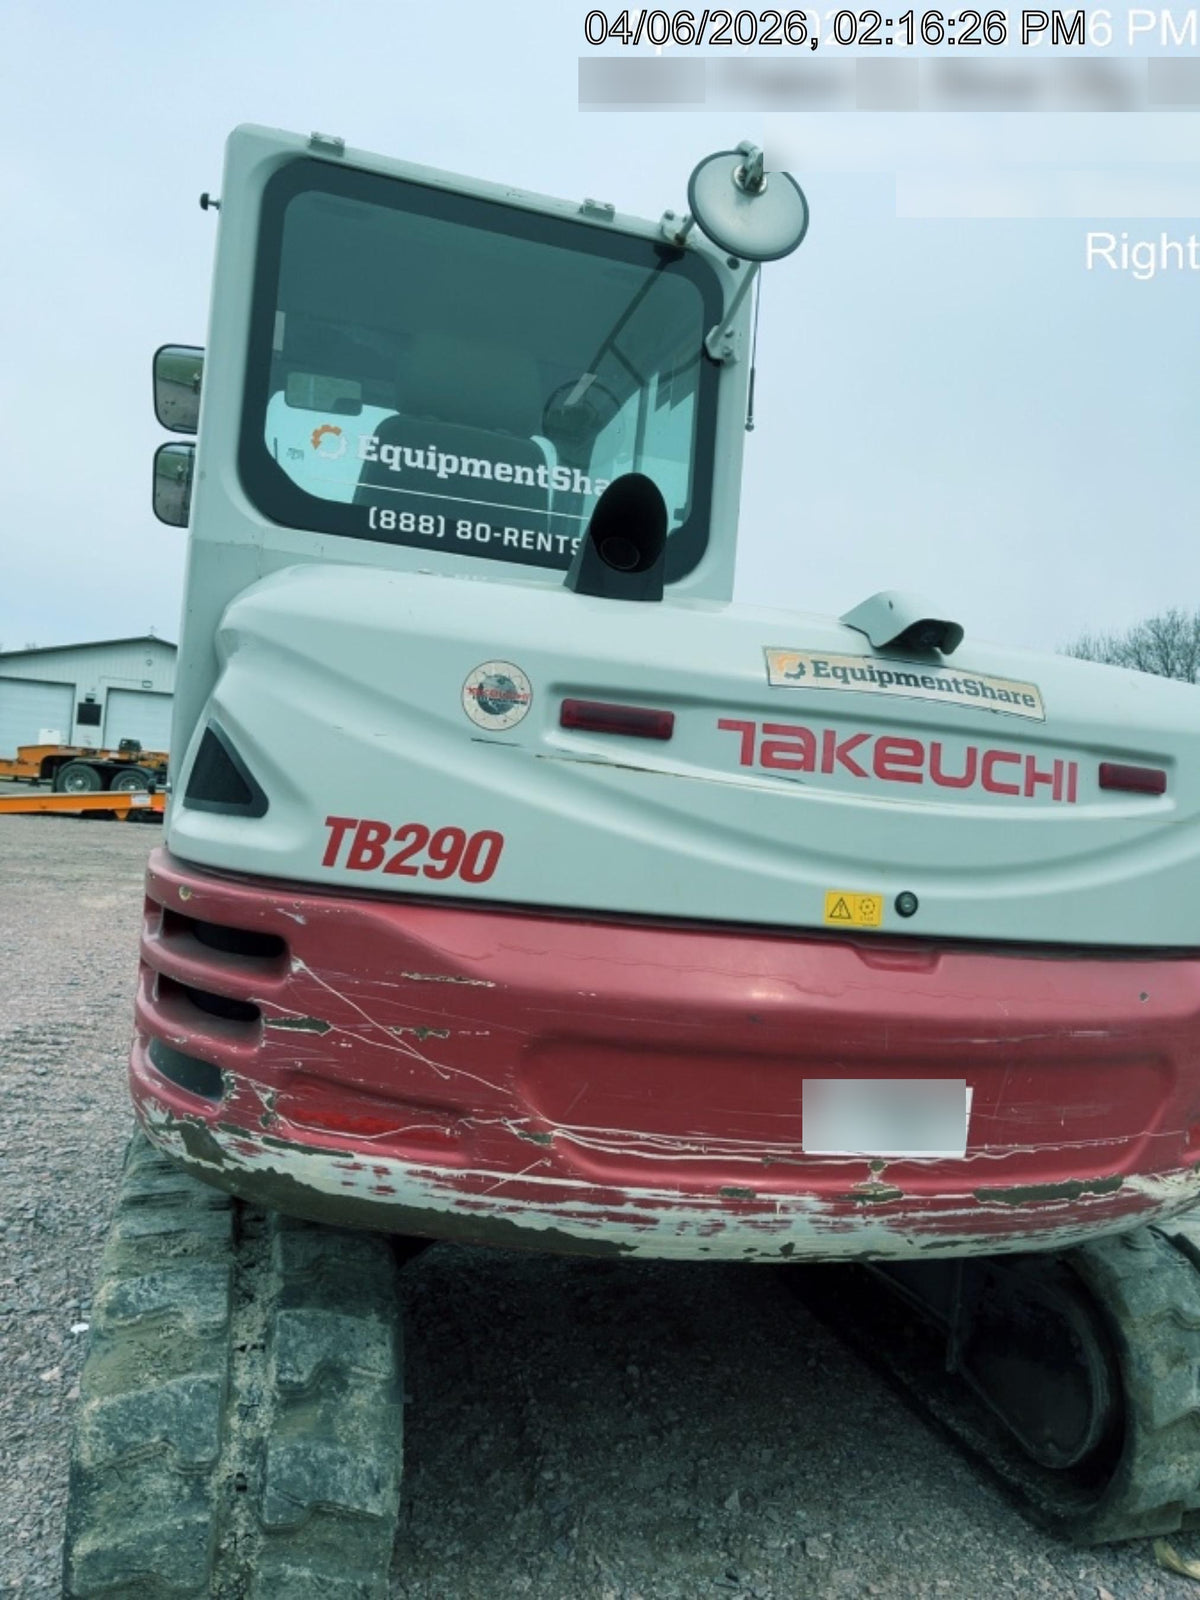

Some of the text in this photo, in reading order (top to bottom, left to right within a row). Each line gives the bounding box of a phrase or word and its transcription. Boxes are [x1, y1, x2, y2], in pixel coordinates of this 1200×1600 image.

[357, 434, 612, 497] EquipmentSha
[369, 505, 445, 538] (888)
[811, 659, 1037, 709] EquipmentShare
[717, 717, 1078, 804] TAKEUCHI
[321, 815, 505, 884] TB290
